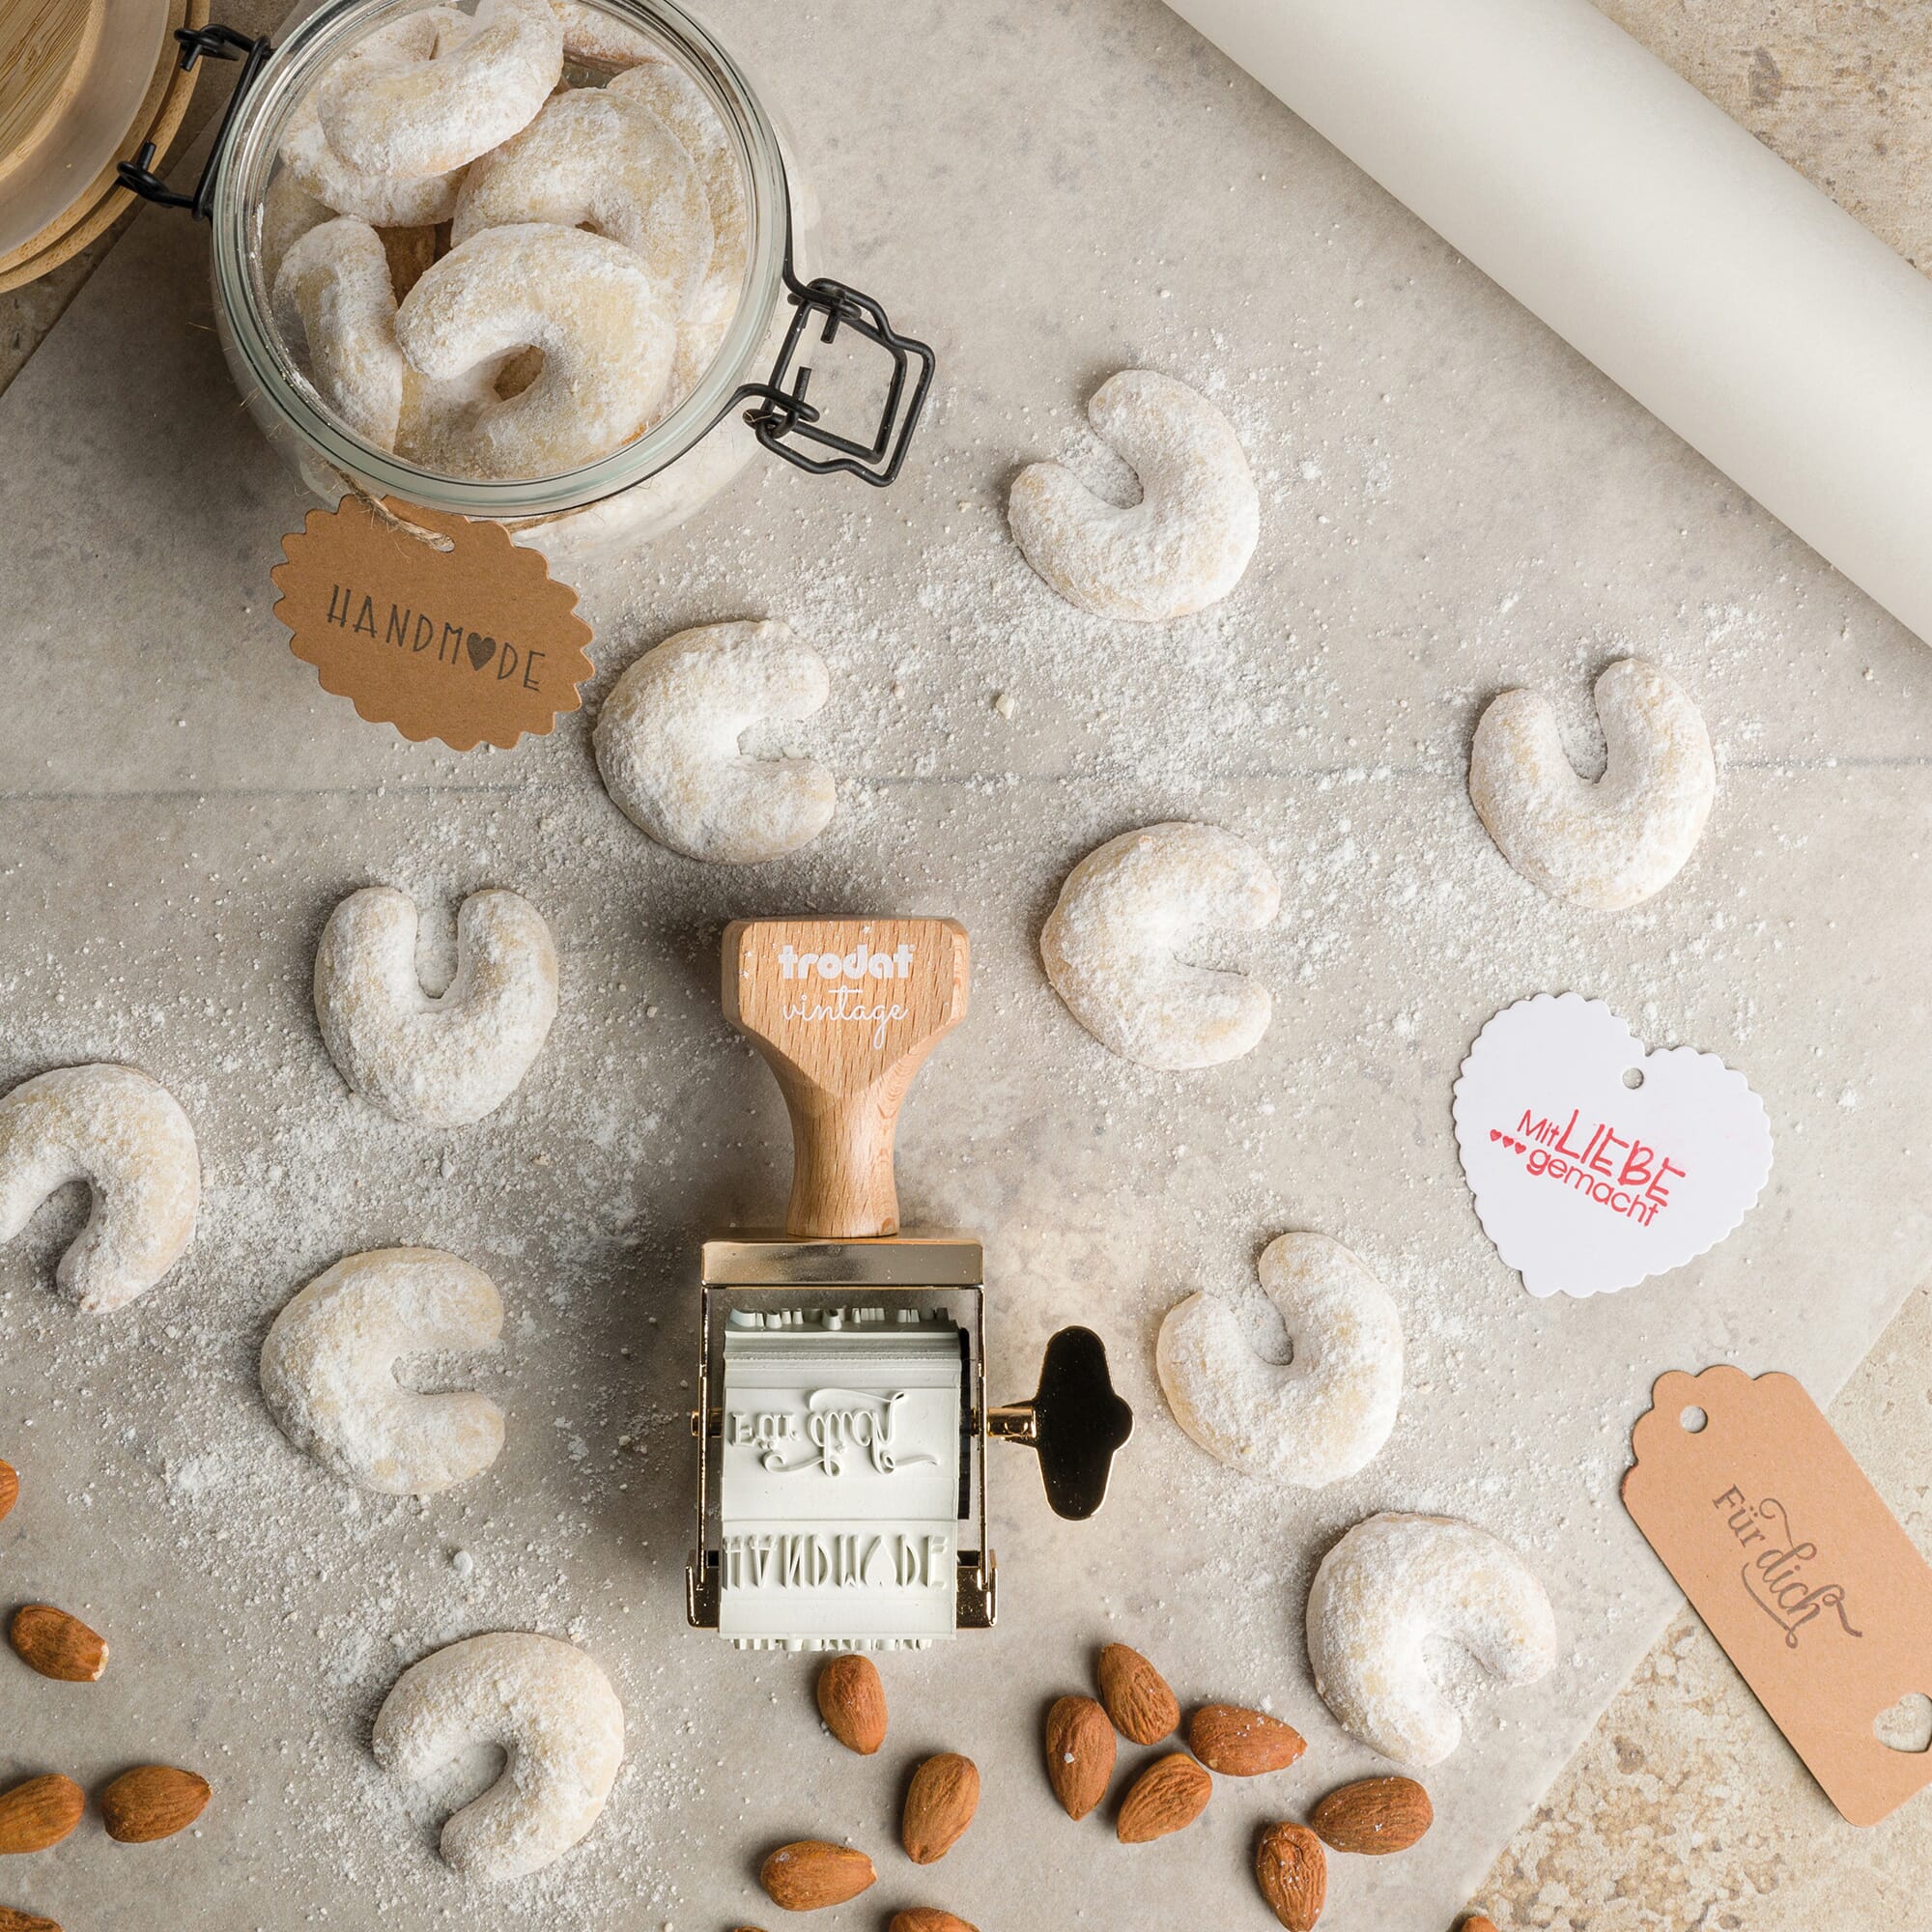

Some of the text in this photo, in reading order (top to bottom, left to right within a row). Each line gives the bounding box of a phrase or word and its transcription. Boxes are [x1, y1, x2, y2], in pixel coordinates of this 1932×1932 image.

[781, 984, 909, 1050] vintage
[1517, 1109, 1686, 1208] Mit LIEBE
[1525, 1149, 1659, 1227] gemacht
[1712, 1484, 1862, 1649] Für dich
